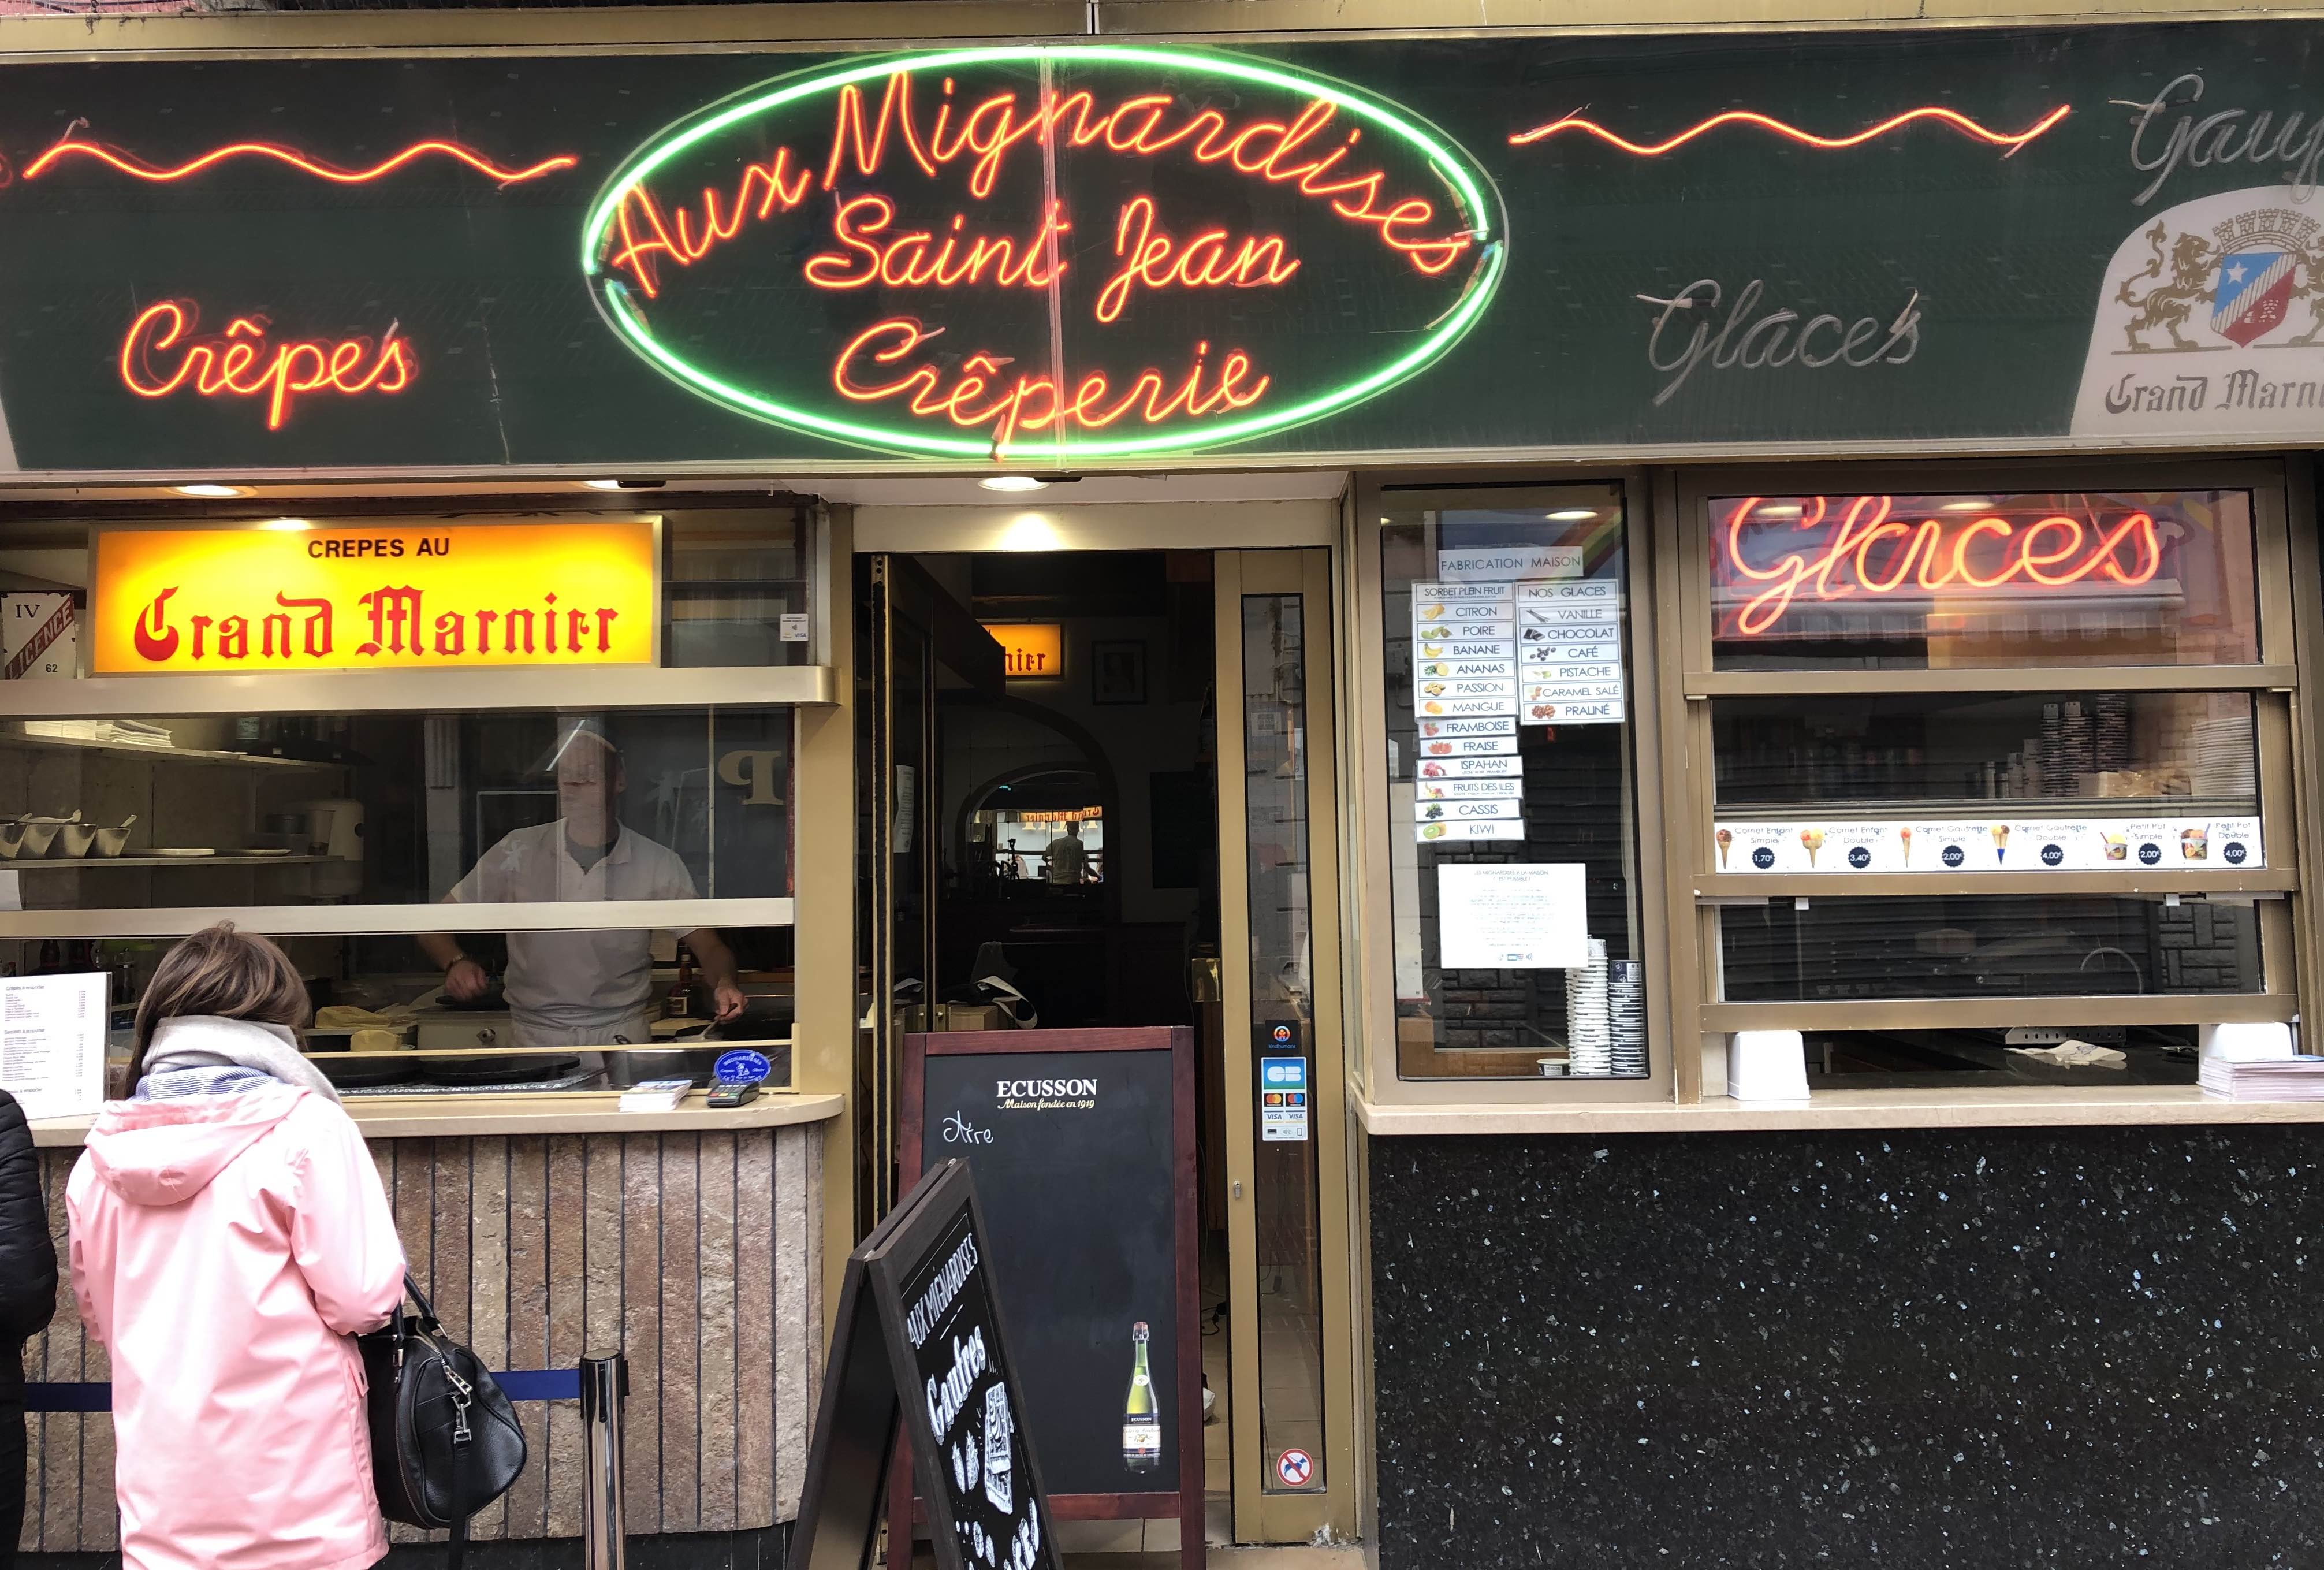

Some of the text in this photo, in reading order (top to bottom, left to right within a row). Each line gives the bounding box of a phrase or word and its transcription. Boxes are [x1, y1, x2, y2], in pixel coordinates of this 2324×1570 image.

[613, 70, 1470, 298] Aux Mignardises
[805, 196, 1301, 323] Saint Jean
[1649, 279, 1922, 407] Glaces
[122, 301, 409, 430] Crêpes
[834, 321, 1269, 459] Crêperie
[2105, 374, 2208, 415] Grand
[308, 538, 449, 558] CREPES AU
[1442, 556, 1580, 571] FABRICATION MAISON
[1729, 496, 2161, 635] Glaces
[1424, 586, 1505, 596] SORBET PLEIN FRUIT
[1529, 586, 1606, 597] NOS GLACES
[16, 604, 40, 618] IV
[1455, 607, 1497, 617] CITRON
[1558, 609, 1602, 619] VANILLE
[134, 585, 619, 661] Grand Marnier
[1463, 626, 1495, 635] POIRE
[1548, 628, 1614, 639] CHOCOLAT
[1453, 645, 1500, 655] BANANE
[1568, 645, 1599, 658] CAFÉ
[46, 664, 58, 672] 62
[1457, 664, 1505, 674] ANANAS
[1560, 667, 1611, 677] PISTACHE
[1457, 683, 1504, 693] PASSION
[1543, 684, 1619, 697] CARAMEL SALÉ
[1452, 702, 1505, 712] MANGUE
[1565, 703, 1610, 716] PRALINÉ
[1446, 721, 1509, 732] FRAMBOISE
[1463, 741, 1499, 751] FRAISE
[1461, 760, 1507, 769] ISPAHAN
[1453, 783, 1479, 791] FRUITS
[1481, 783, 1497, 791] DES
[1458, 804, 1498, 815] CASSIS
[1469, 824, 1494, 834] KIWI
[996, 1078, 1097, 1097] ECUSSON
[997, 1098, 1095, 1111] Maison fondée en 1919
[907, 1232, 978, 1351] AUX MIGNARDISES
[926, 1325, 986, 1446] Gaufres
